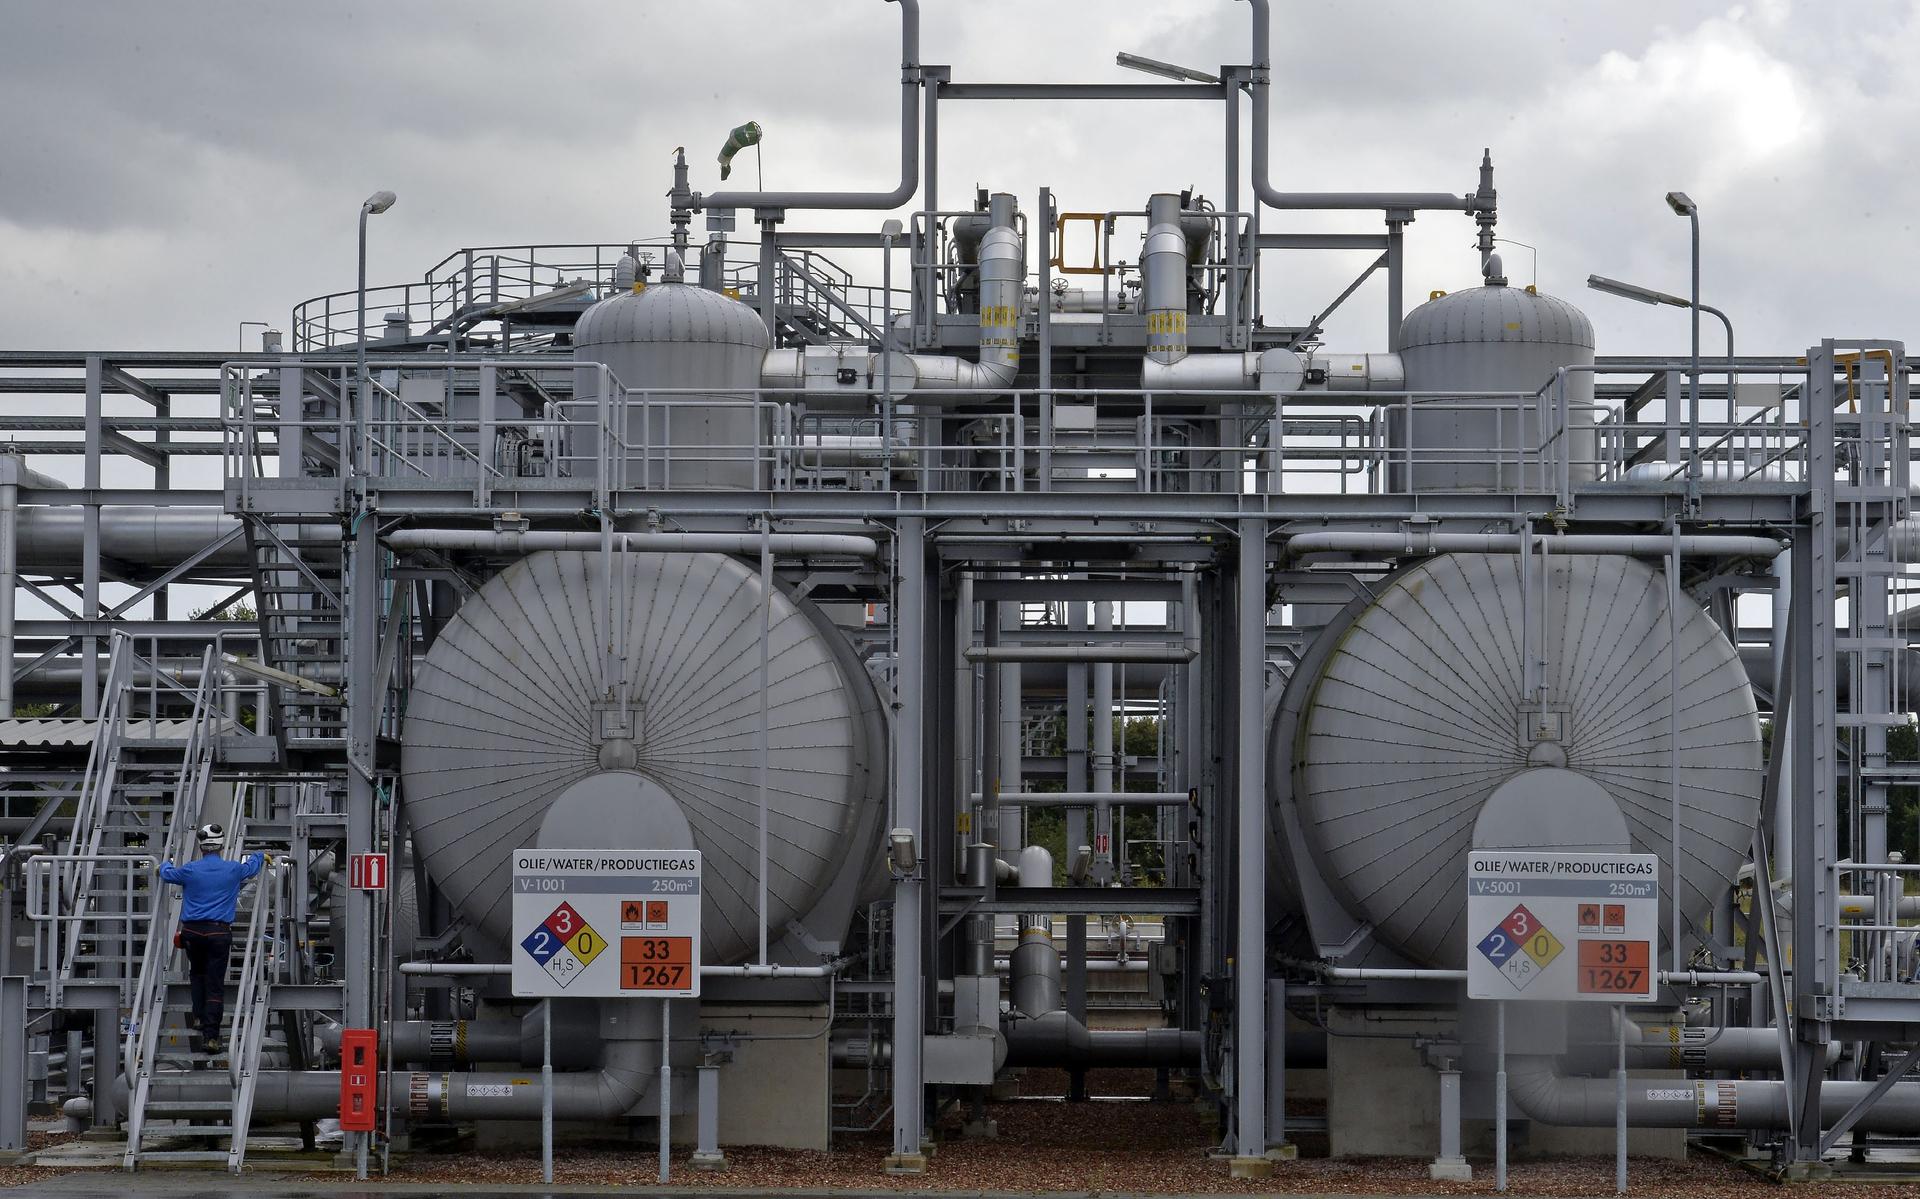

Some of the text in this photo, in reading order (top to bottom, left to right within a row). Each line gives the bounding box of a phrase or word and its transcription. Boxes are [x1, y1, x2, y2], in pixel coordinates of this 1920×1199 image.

[518, 857, 696, 872] OLIE/WATER/PRODUCTIEGAS
[1474, 860, 1653, 875] OLIE/WATER/PRODUCTIEGAS
[520, 878, 566, 892] V-1001
[1476, 881, 1521, 894] V-5001
[555, 909, 572, 934] 3
[1512, 912, 1528, 936] 3
[533, 931, 550, 955] 2
[577, 932, 593, 955] 0
[642, 940, 670, 960] 33
[1489, 934, 1506, 957] 2
[1534, 935, 1549, 957] 0
[1600, 943, 1628, 963] 33
[631, 966, 685, 986] 1267
[1588, 968, 1642, 990] 1267
